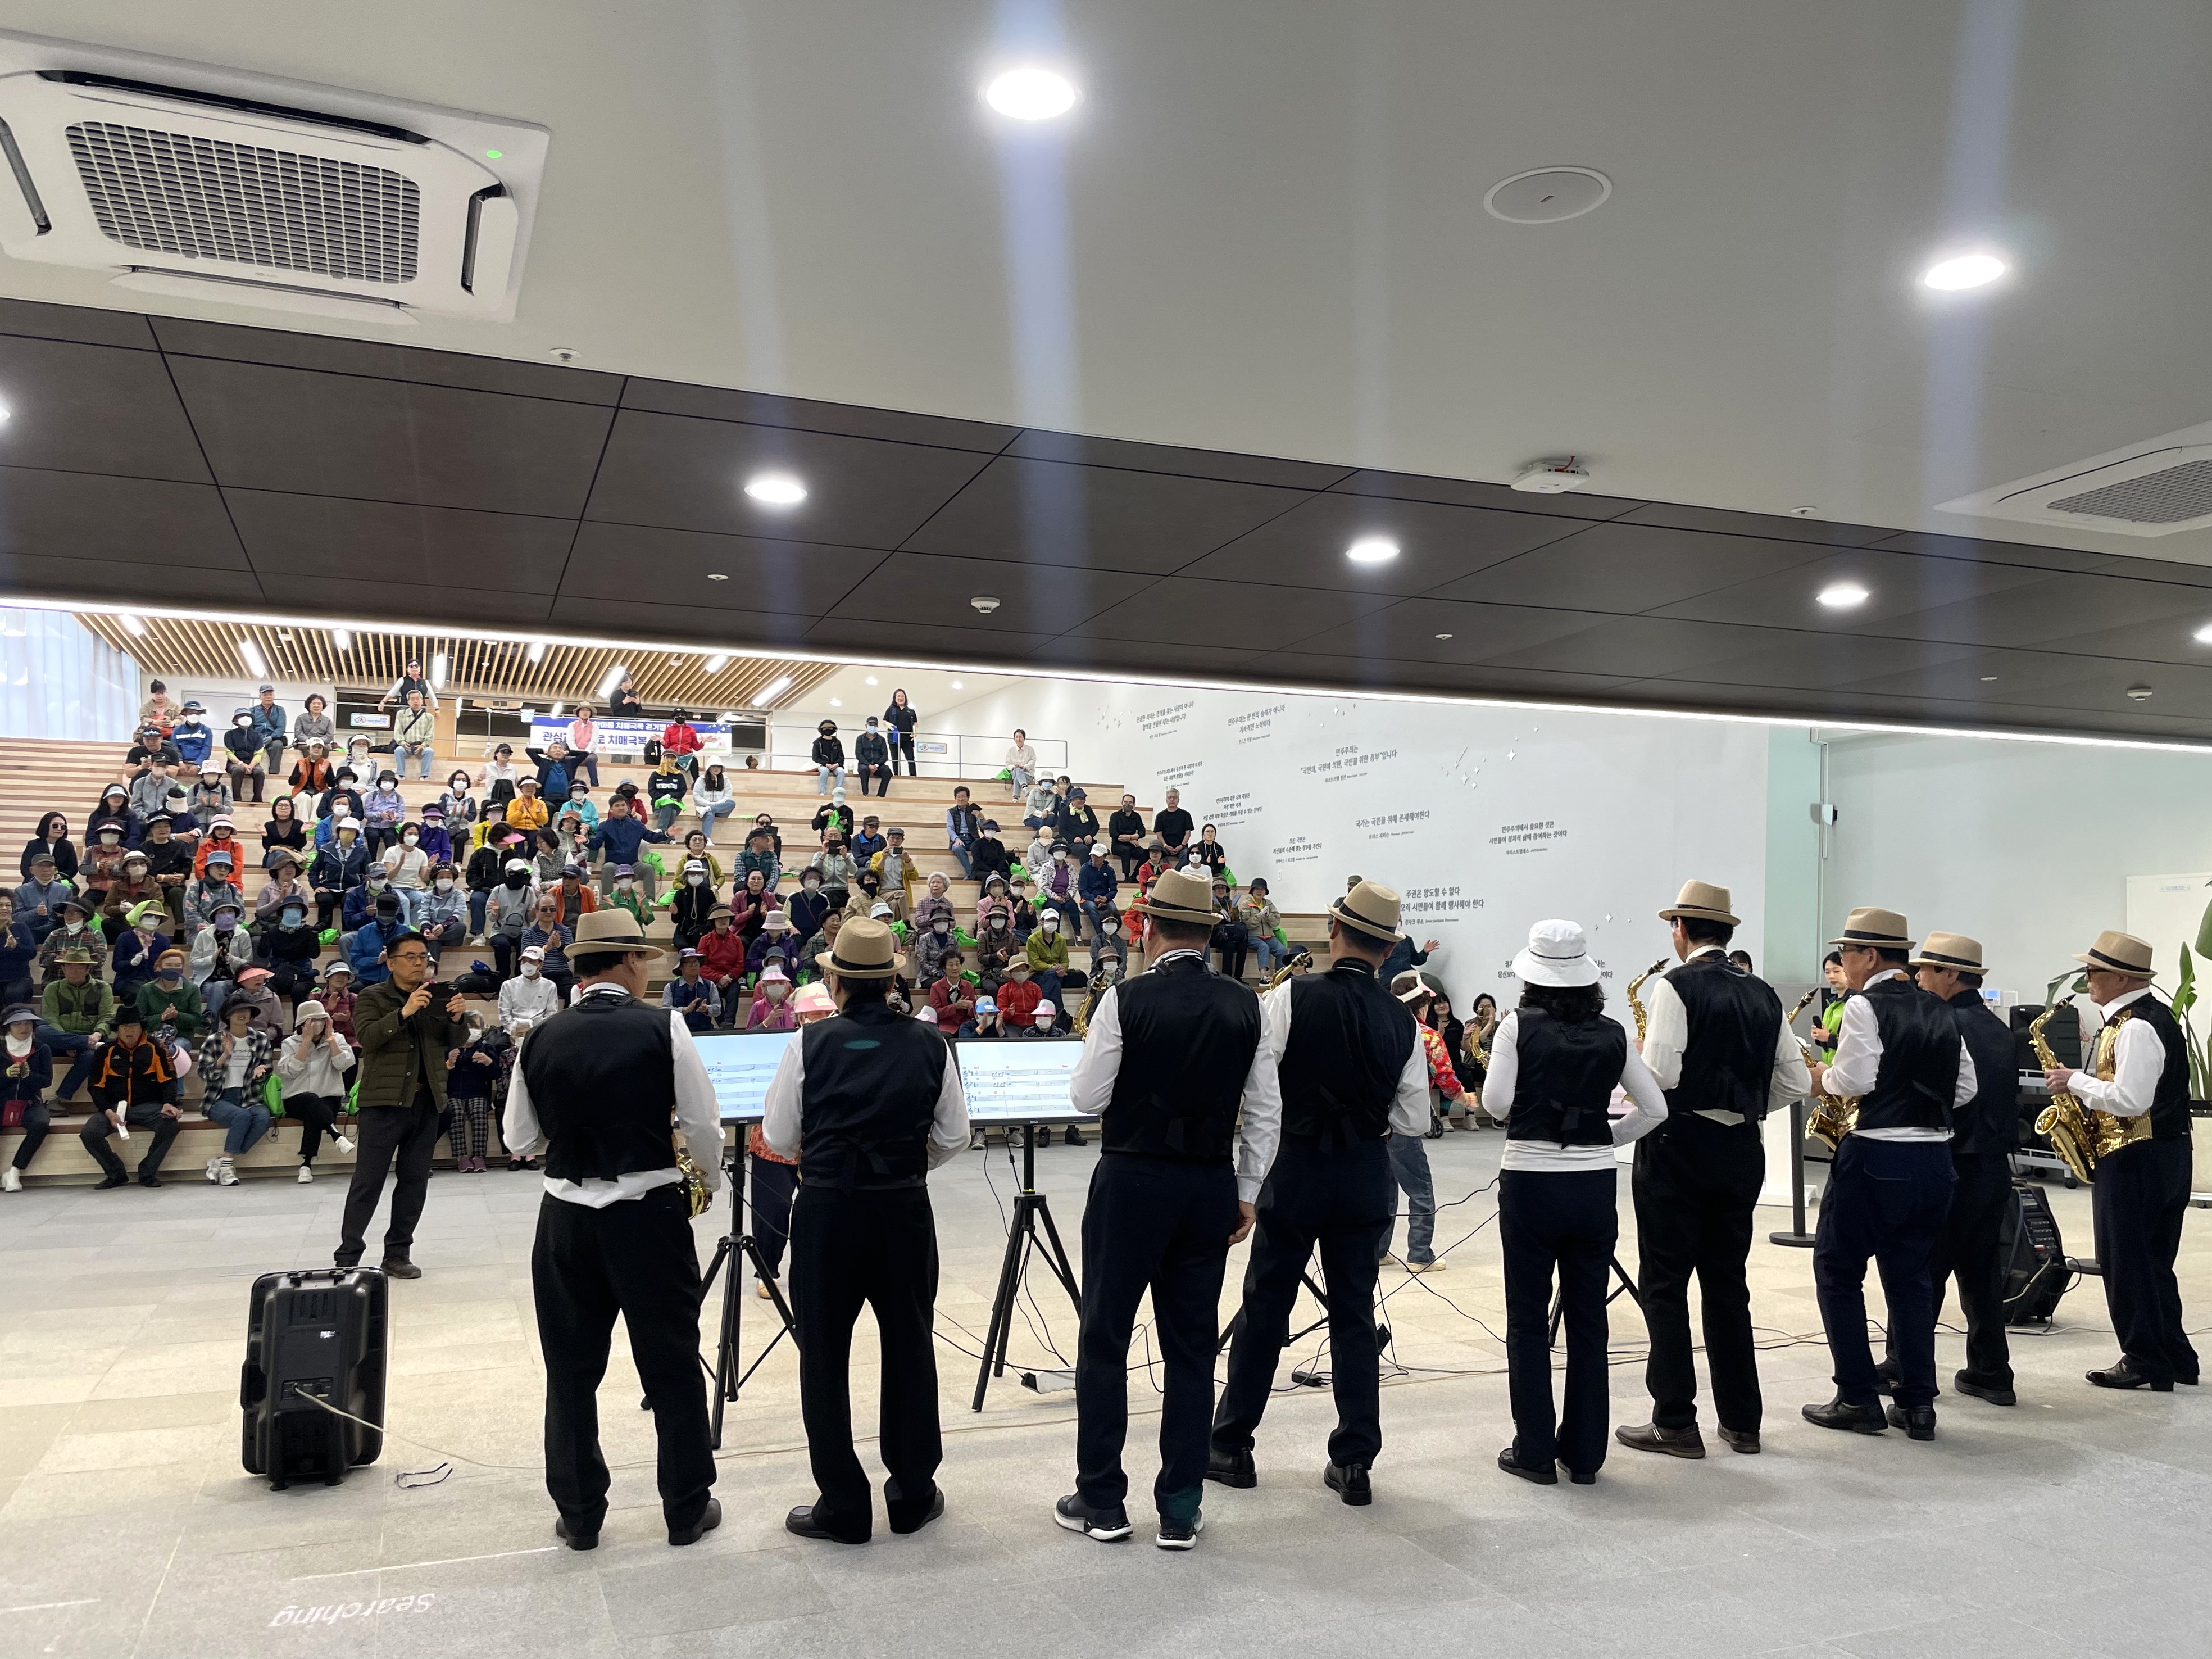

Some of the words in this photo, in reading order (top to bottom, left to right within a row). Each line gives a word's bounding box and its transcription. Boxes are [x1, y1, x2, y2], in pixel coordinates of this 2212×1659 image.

[616, 722, 644, 731] 치매극복
[608, 735, 647, 745] 치매극복
[1336, 745, 1358, 756] 민주주의는
[1344, 757, 1357, 767] 국민을
[1359, 754, 1368, 764] 위한
[1356, 819, 1370, 828] 국가는
[1371, 816, 1386, 826] 국민을
[1502, 824, 1528, 833] 민주주의에서
[1489, 836, 1506, 845] 시민들이
[1406, 889, 1421, 899] 주권은
[1424, 887, 1439, 898] 양도할
[1442, 887, 1447, 896] 수
[1448, 886, 1460, 896] 없다
[1400, 903, 1410, 912] 오직
[1412, 901, 1433, 912] 시민들이
[1436, 901, 1446, 910] 함께
[1448, 899, 1470, 910] 행사해야
[1473, 899, 1484, 909] 한다
[267, 1593, 435, 1628] Searching
